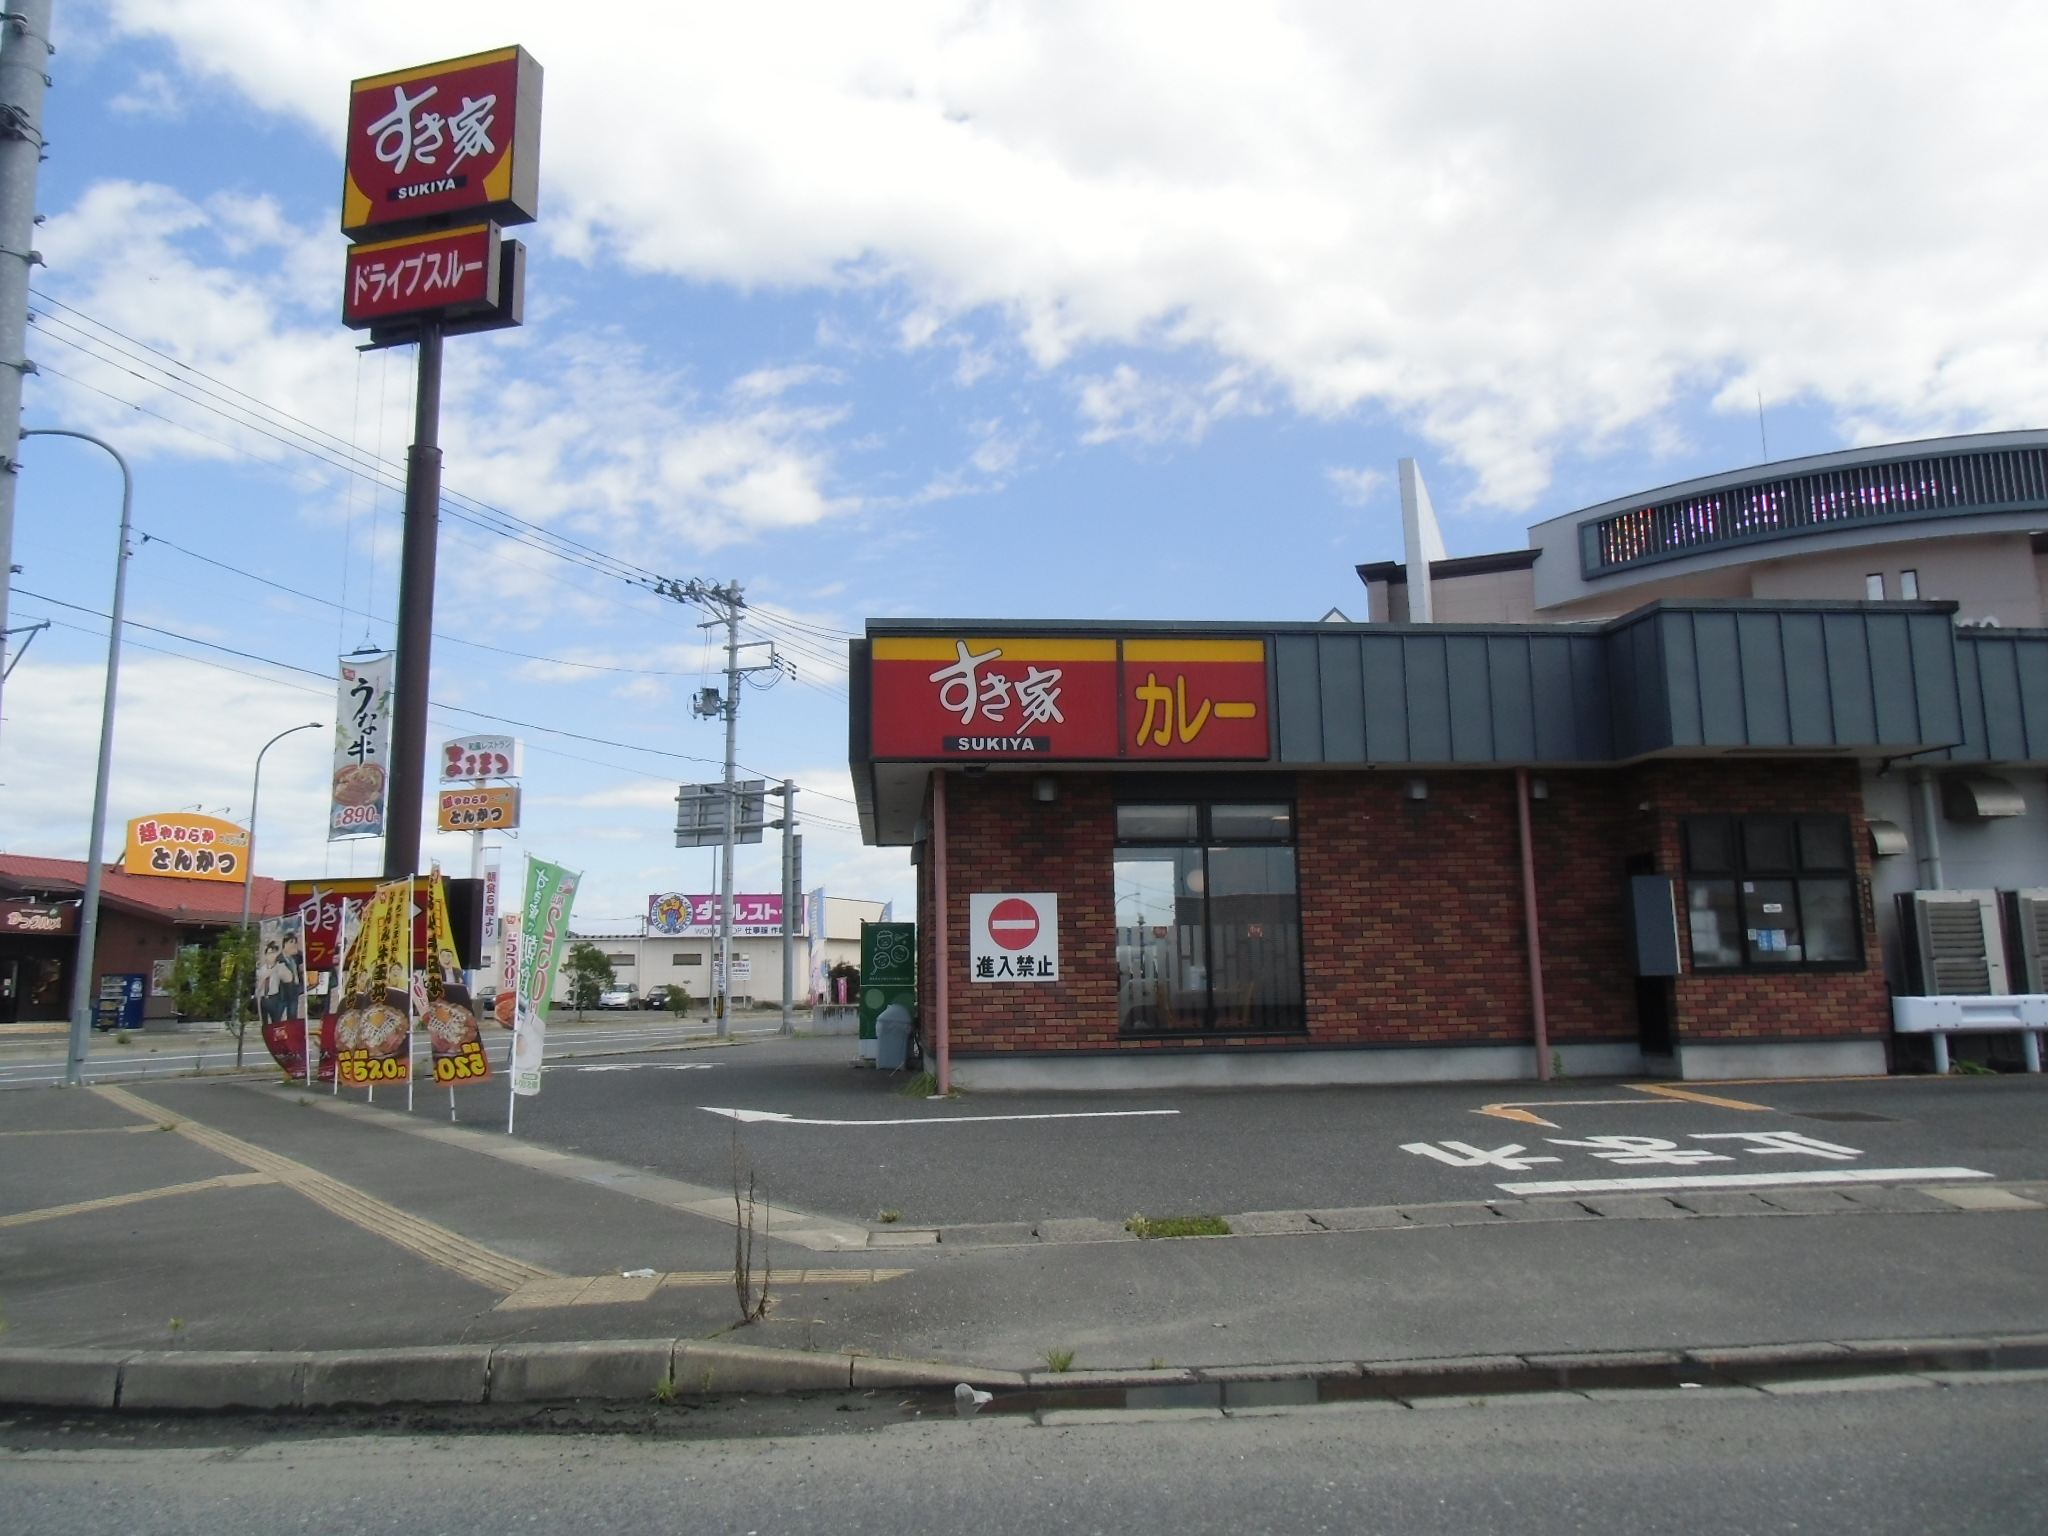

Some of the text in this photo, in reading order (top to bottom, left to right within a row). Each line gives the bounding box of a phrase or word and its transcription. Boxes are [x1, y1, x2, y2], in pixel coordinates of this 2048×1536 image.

[367, 85, 496, 174] すき家
[398, 178, 456, 199] SUKIYA
[354, 249, 483, 306] ドライブスルー
[929, 640, 1065, 735] すき家
[347, 677, 375, 768] うな牛
[1135, 672, 1257, 747] カレー
[957, 737, 1036, 751] SUKIYA
[442, 795, 488, 809] 超やわらか
[449, 807, 503, 825] とんかつ
[138, 819, 216, 845] 超やわらか
[150, 845, 237, 876] とんかつ
[486, 871, 497, 937] 朝食6時より
[975, 954, 1055, 979] 進入禁止
[353, 1058, 407, 1082] 520円
[1398, 1131, 1866, 1171] 止まれ
